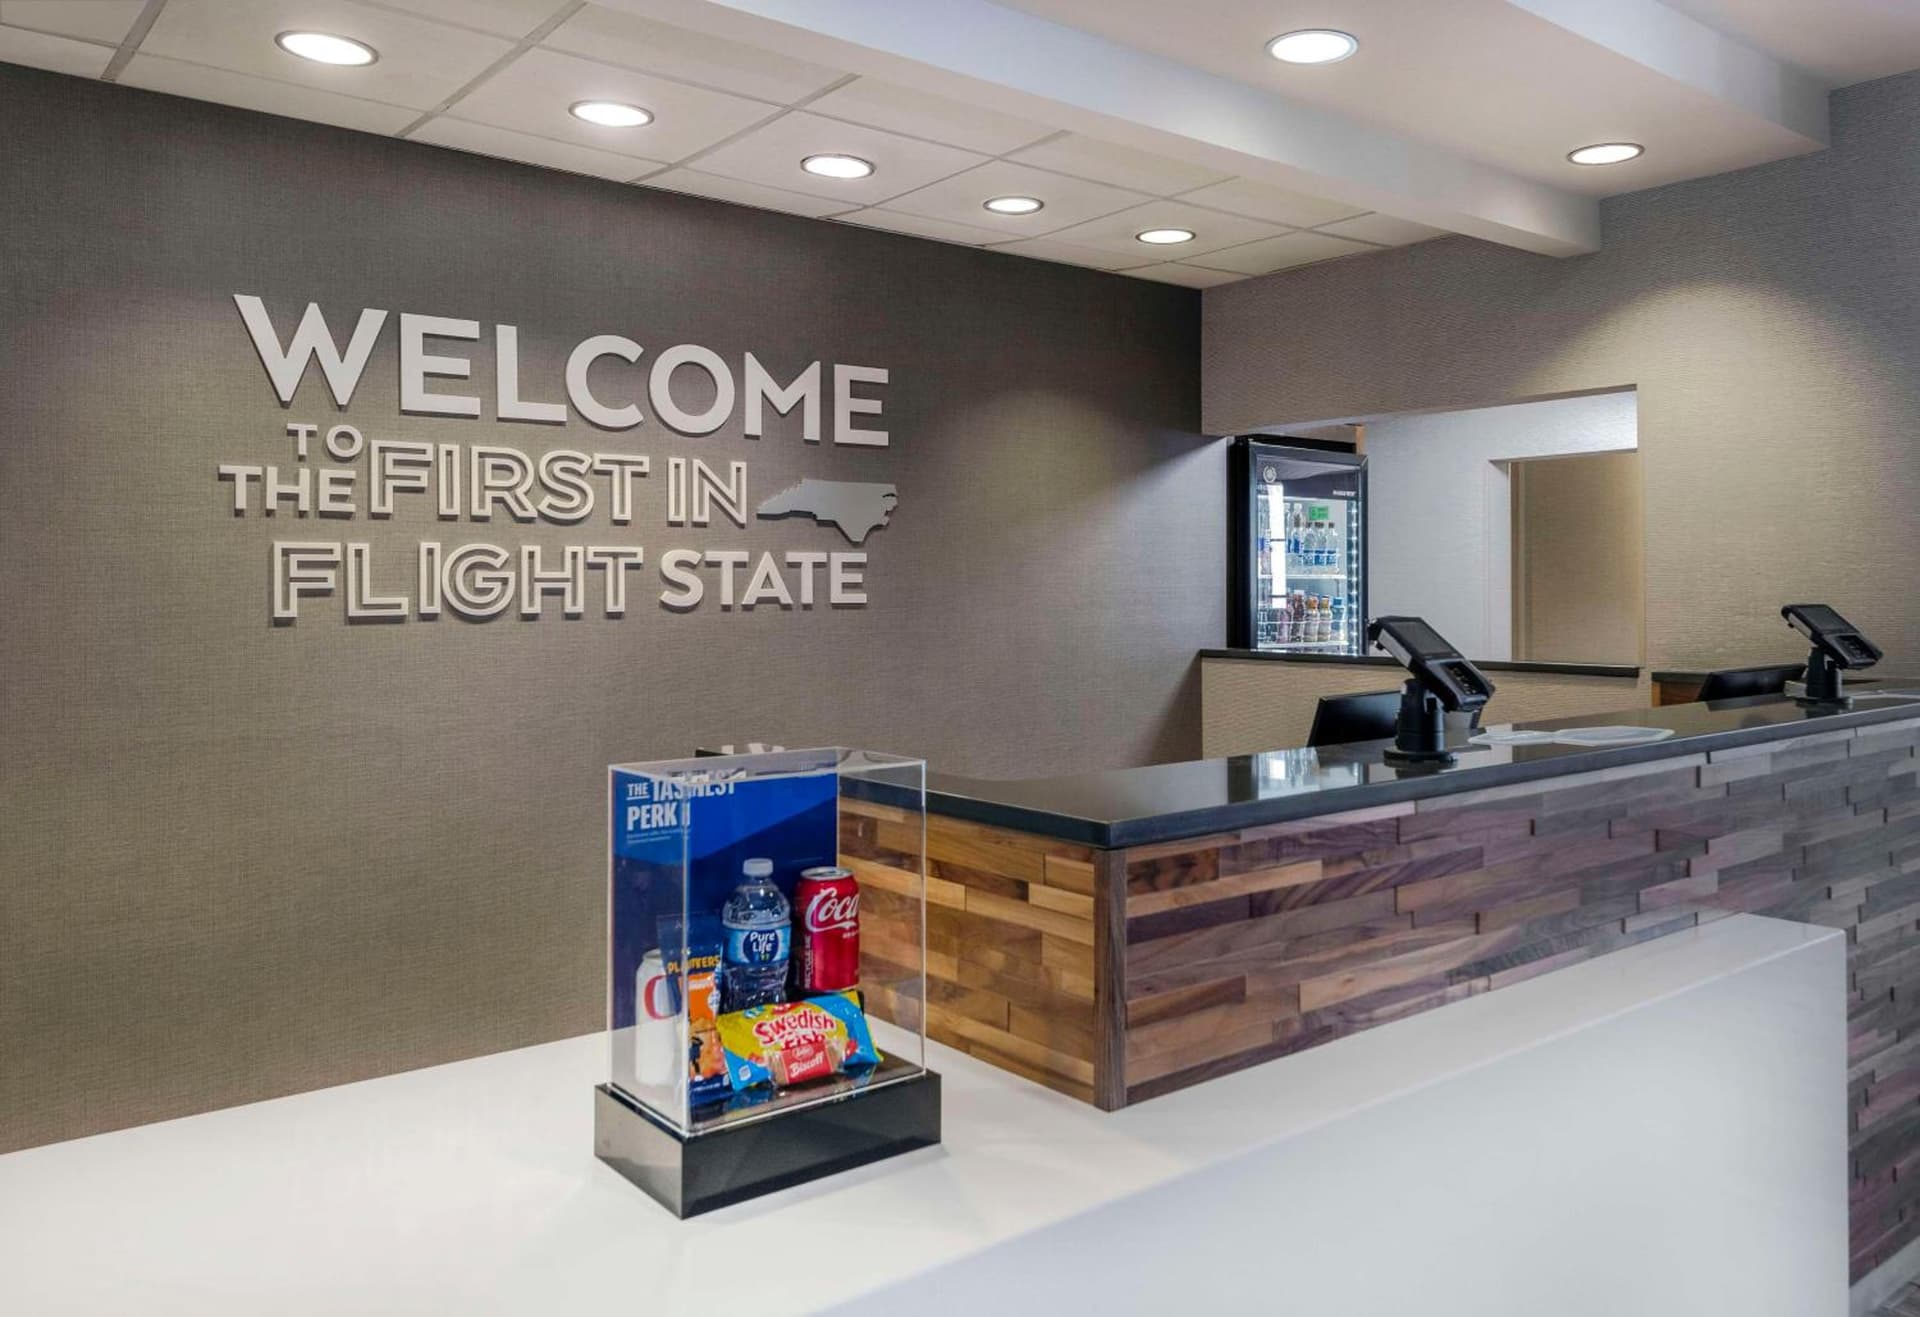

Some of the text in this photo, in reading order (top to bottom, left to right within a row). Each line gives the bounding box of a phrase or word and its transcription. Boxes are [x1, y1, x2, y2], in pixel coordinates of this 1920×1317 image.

[233, 294, 889, 447] WELCOME
[286, 423, 363, 459] TO
[218, 440, 748, 526] THE FIRST IN
[272, 541, 868, 625] FLIGHT STATE
[626, 783, 649, 797] THE
[626, 802, 678, 831] PERK
[805, 887, 860, 932] Coca
[750, 931, 775, 943] Pure
[752, 942, 772, 955] Life
[753, 1009, 836, 1045] Swedish
